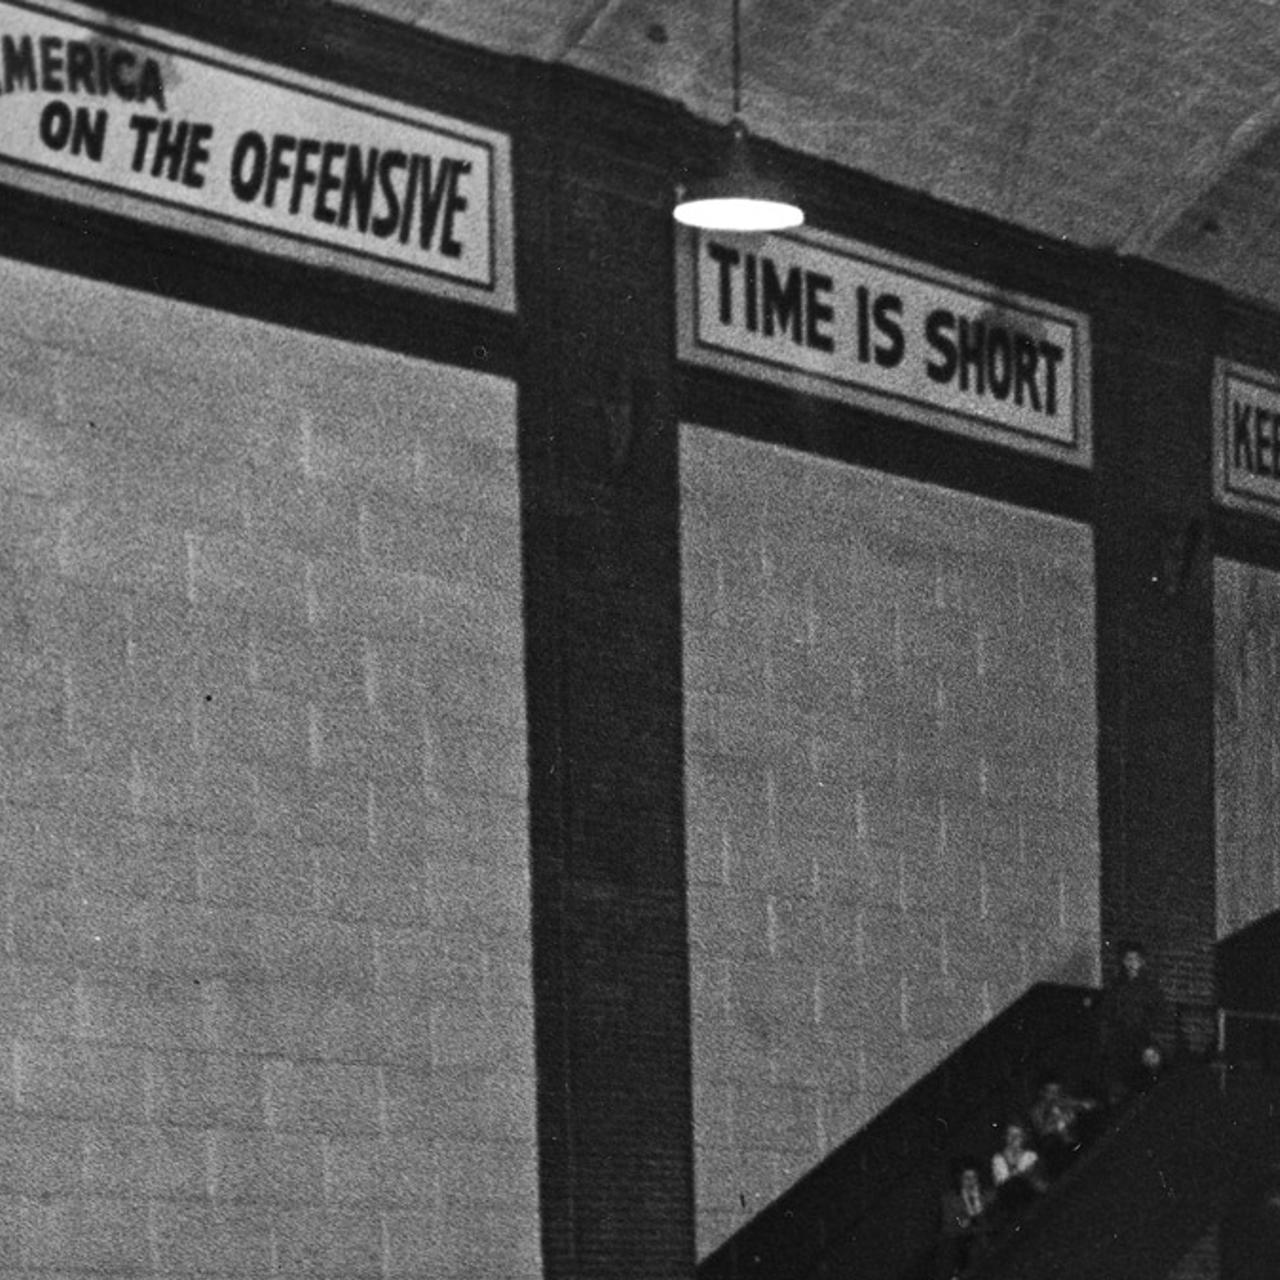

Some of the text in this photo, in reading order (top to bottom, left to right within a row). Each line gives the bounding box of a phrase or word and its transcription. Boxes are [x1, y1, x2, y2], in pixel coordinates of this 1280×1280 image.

[0, 34, 167, 112] MERICA
[39, 99, 472, 259] ON THE OFFENSIVE
[706, 240, 1065, 416] TIME IS SHORT
